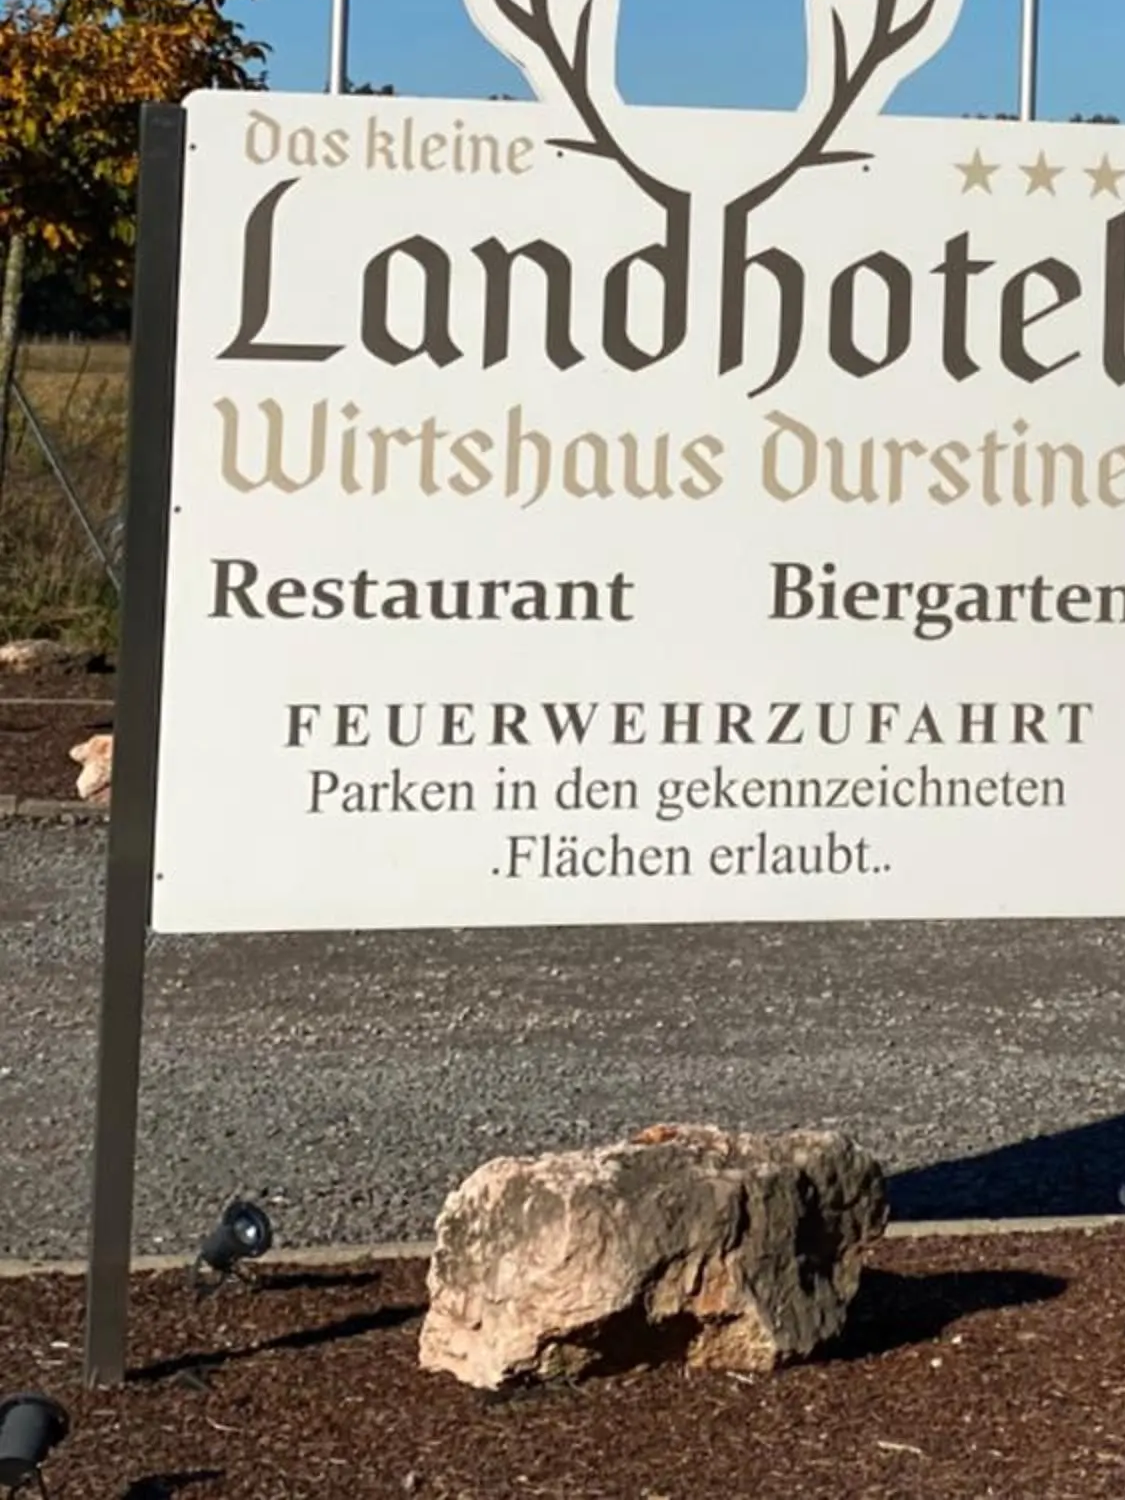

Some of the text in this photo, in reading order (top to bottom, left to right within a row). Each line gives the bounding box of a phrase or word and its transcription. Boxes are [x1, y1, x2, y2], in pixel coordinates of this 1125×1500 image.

[365, 115, 534, 176] kleine
[213, 396, 725, 510] Wirtshaus
[206, 557, 636, 623] Restaurant
[283, 700, 1095, 749] FEUERWEHRZUFAHRT
[305, 763, 1067, 823] Parken in den gekennzeichneten
